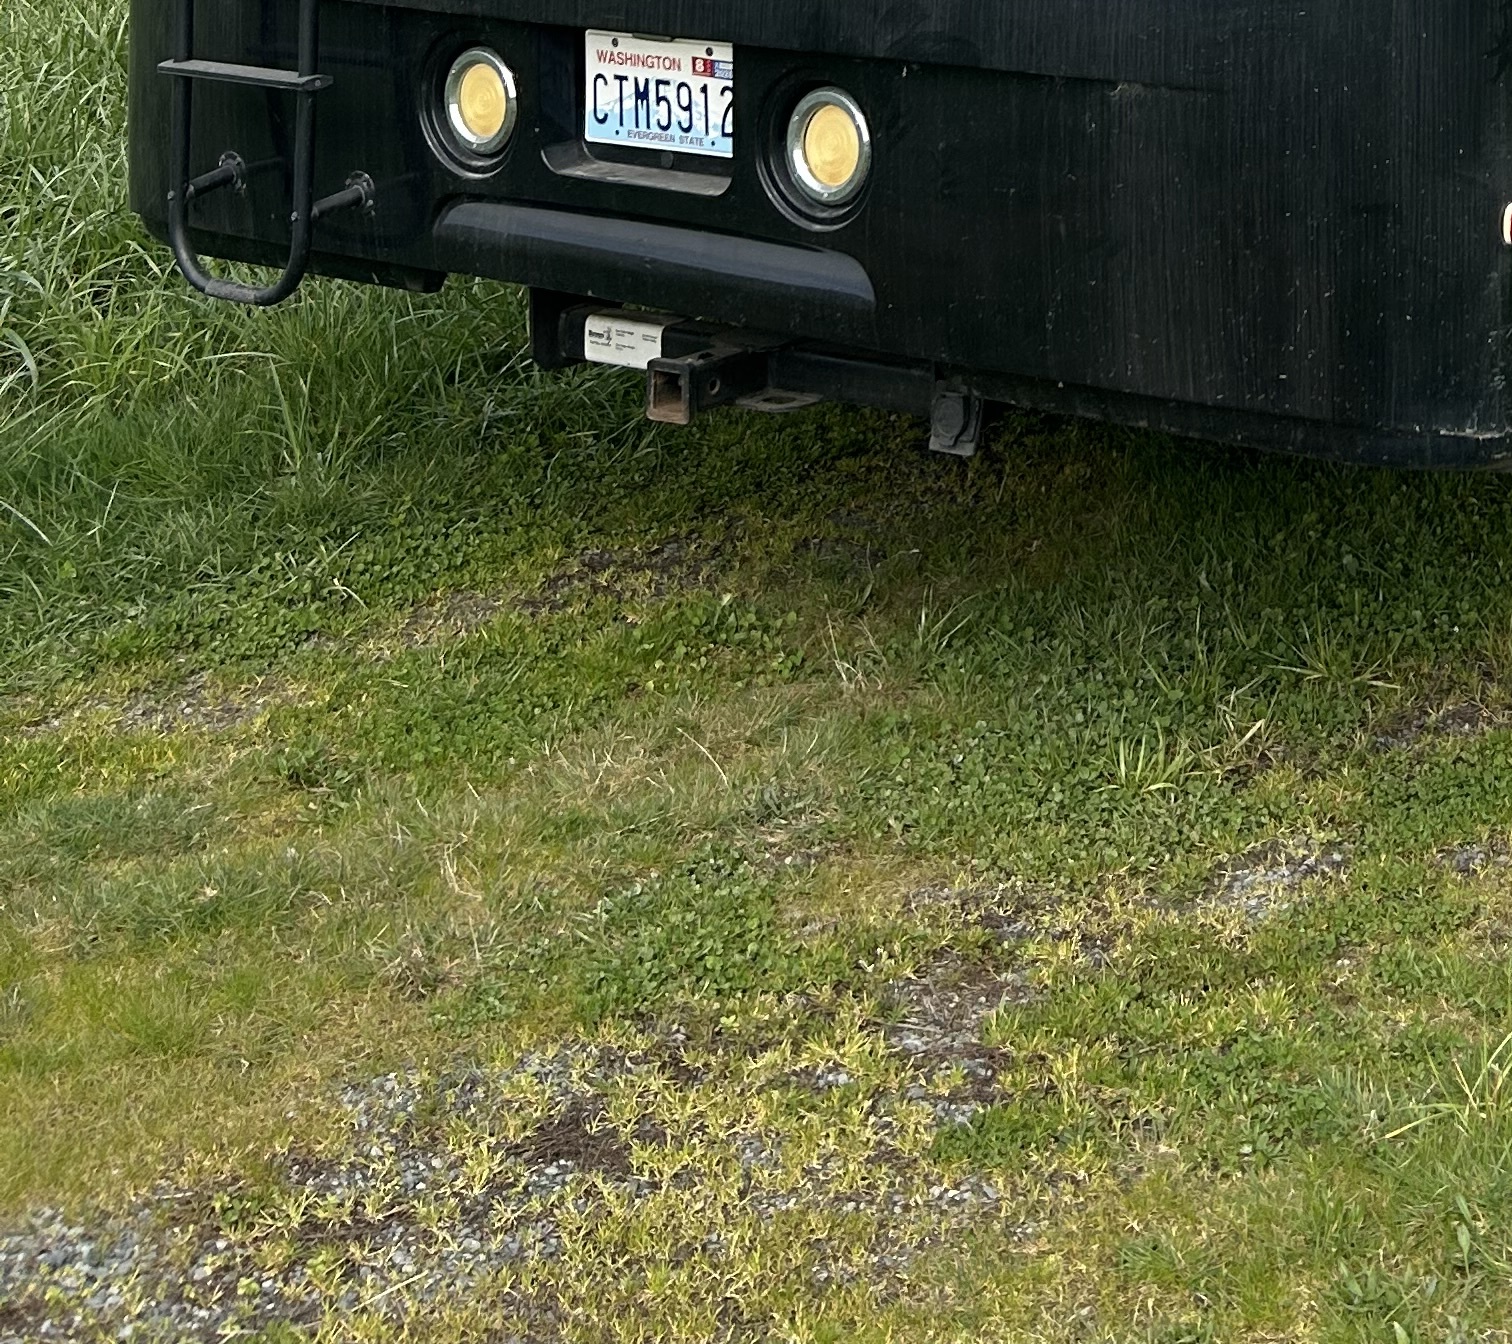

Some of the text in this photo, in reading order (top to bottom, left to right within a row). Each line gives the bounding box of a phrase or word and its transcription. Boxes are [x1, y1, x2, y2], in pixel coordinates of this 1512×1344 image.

[597, 49, 681, 71] WASHINGTON
[695, 58, 705, 73] 8
[593, 73, 733, 138] CTM5912
[627, 129, 705, 147] EVERGREEN STATE
